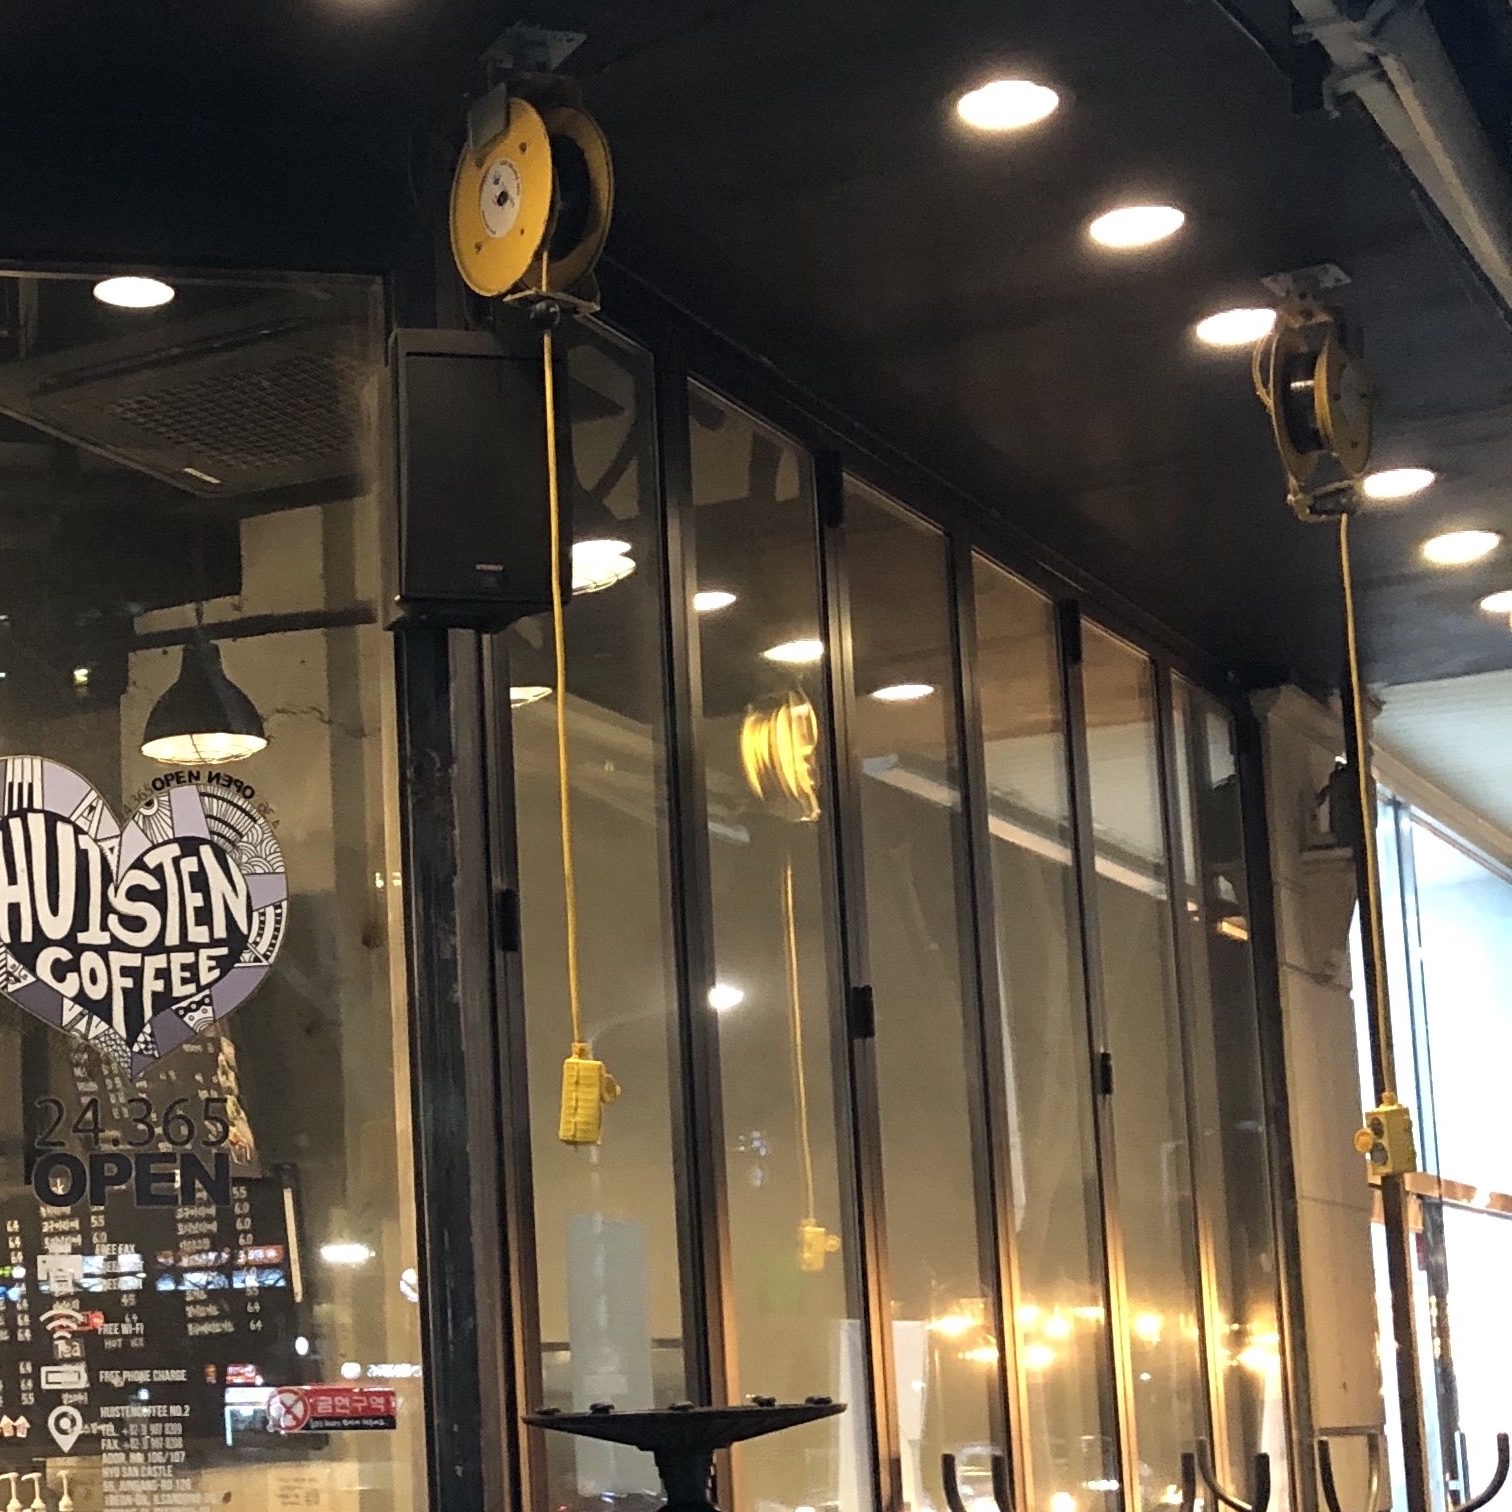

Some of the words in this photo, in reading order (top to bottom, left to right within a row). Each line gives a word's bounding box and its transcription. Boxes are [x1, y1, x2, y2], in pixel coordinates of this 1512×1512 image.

[151, 770, 201, 792] OPEN
[36, 946, 229, 1046] COFFEE
[35, 1097, 231, 1148] 24.365
[32, 1151, 232, 1208] OPEN
[54, 1340, 81, 1359] Tea
[317, 1395, 385, 1414] 금연구역
[140, 1465, 173, 1477] CASTLE
